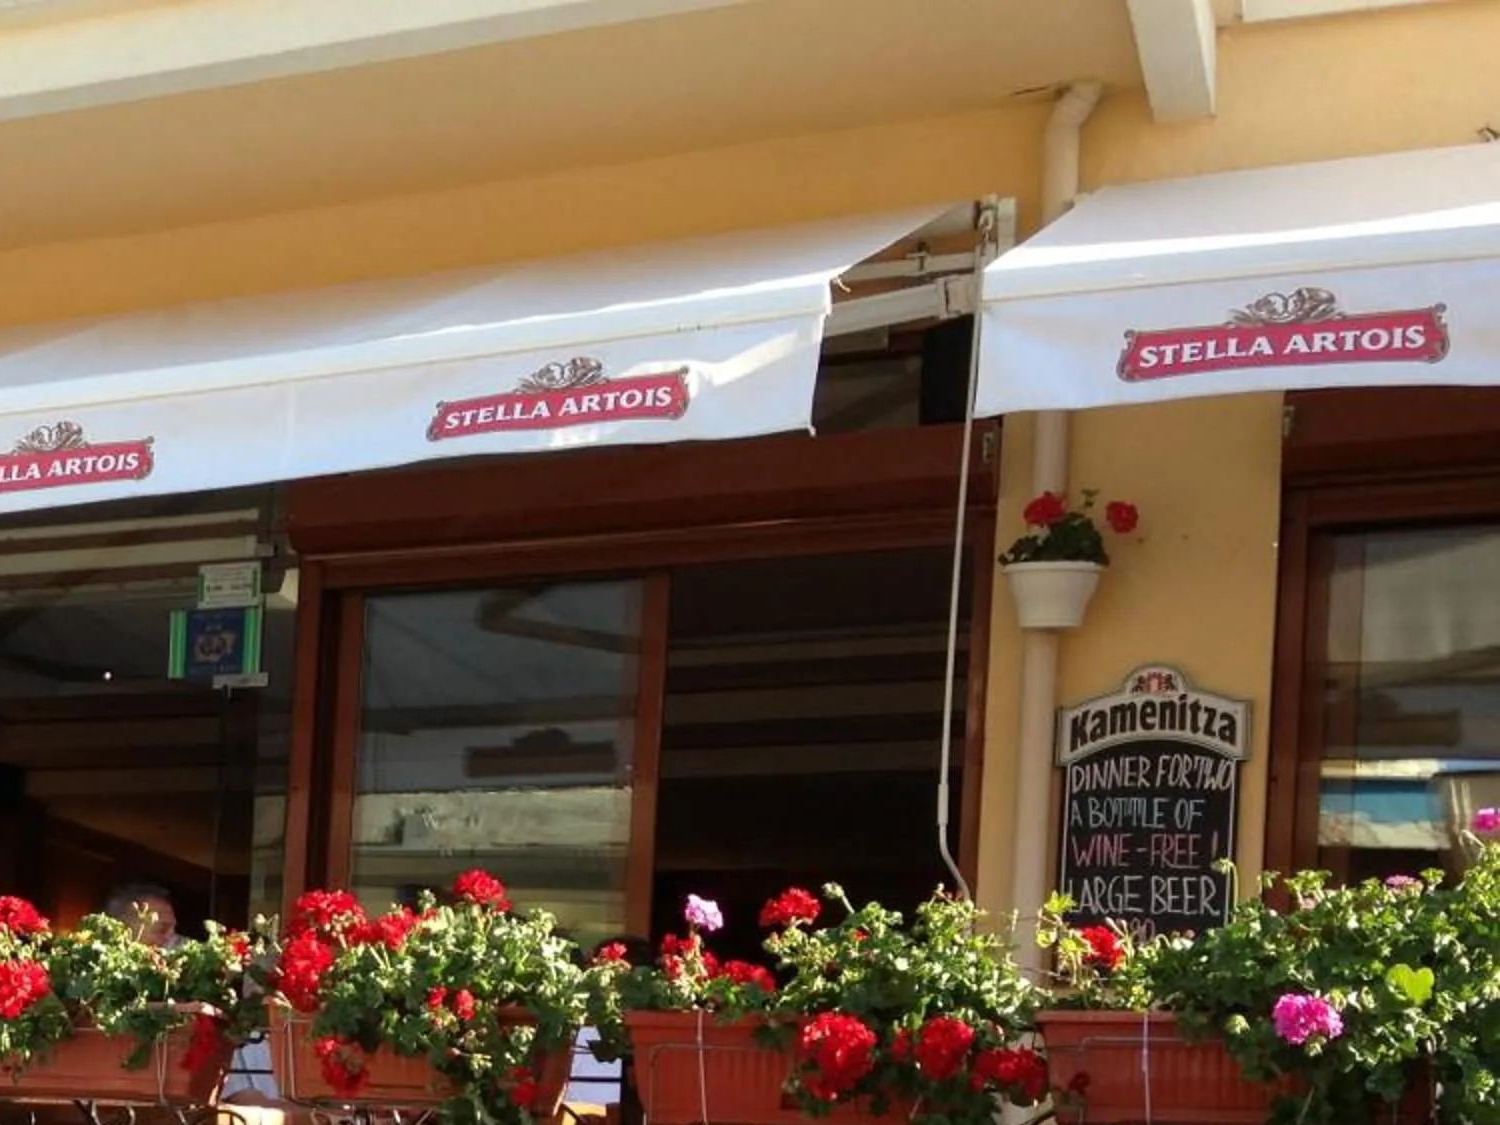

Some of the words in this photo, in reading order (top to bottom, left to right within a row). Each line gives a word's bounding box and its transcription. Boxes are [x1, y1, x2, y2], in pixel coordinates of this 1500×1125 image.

[1139, 335, 1273, 367] STELLA
[1283, 325, 1425, 356] ARTOIS
[445, 400, 551, 430] STELLA
[558, 385, 673, 417] ARTOIS
[47, 452, 140, 478] ARTOIS
[1069, 693, 1237, 753] Kamenitza
[1071, 755, 1150, 794] DINNER
[1155, 753, 1192, 789] FOR
[1070, 800, 1083, 828] A
[1174, 797, 1205, 831] OF
[1071, 832, 1132, 868] WINE
[1151, 832, 1202, 869] FREE
[1068, 874, 1144, 916] LARGE
[1150, 874, 1221, 917] BEER
